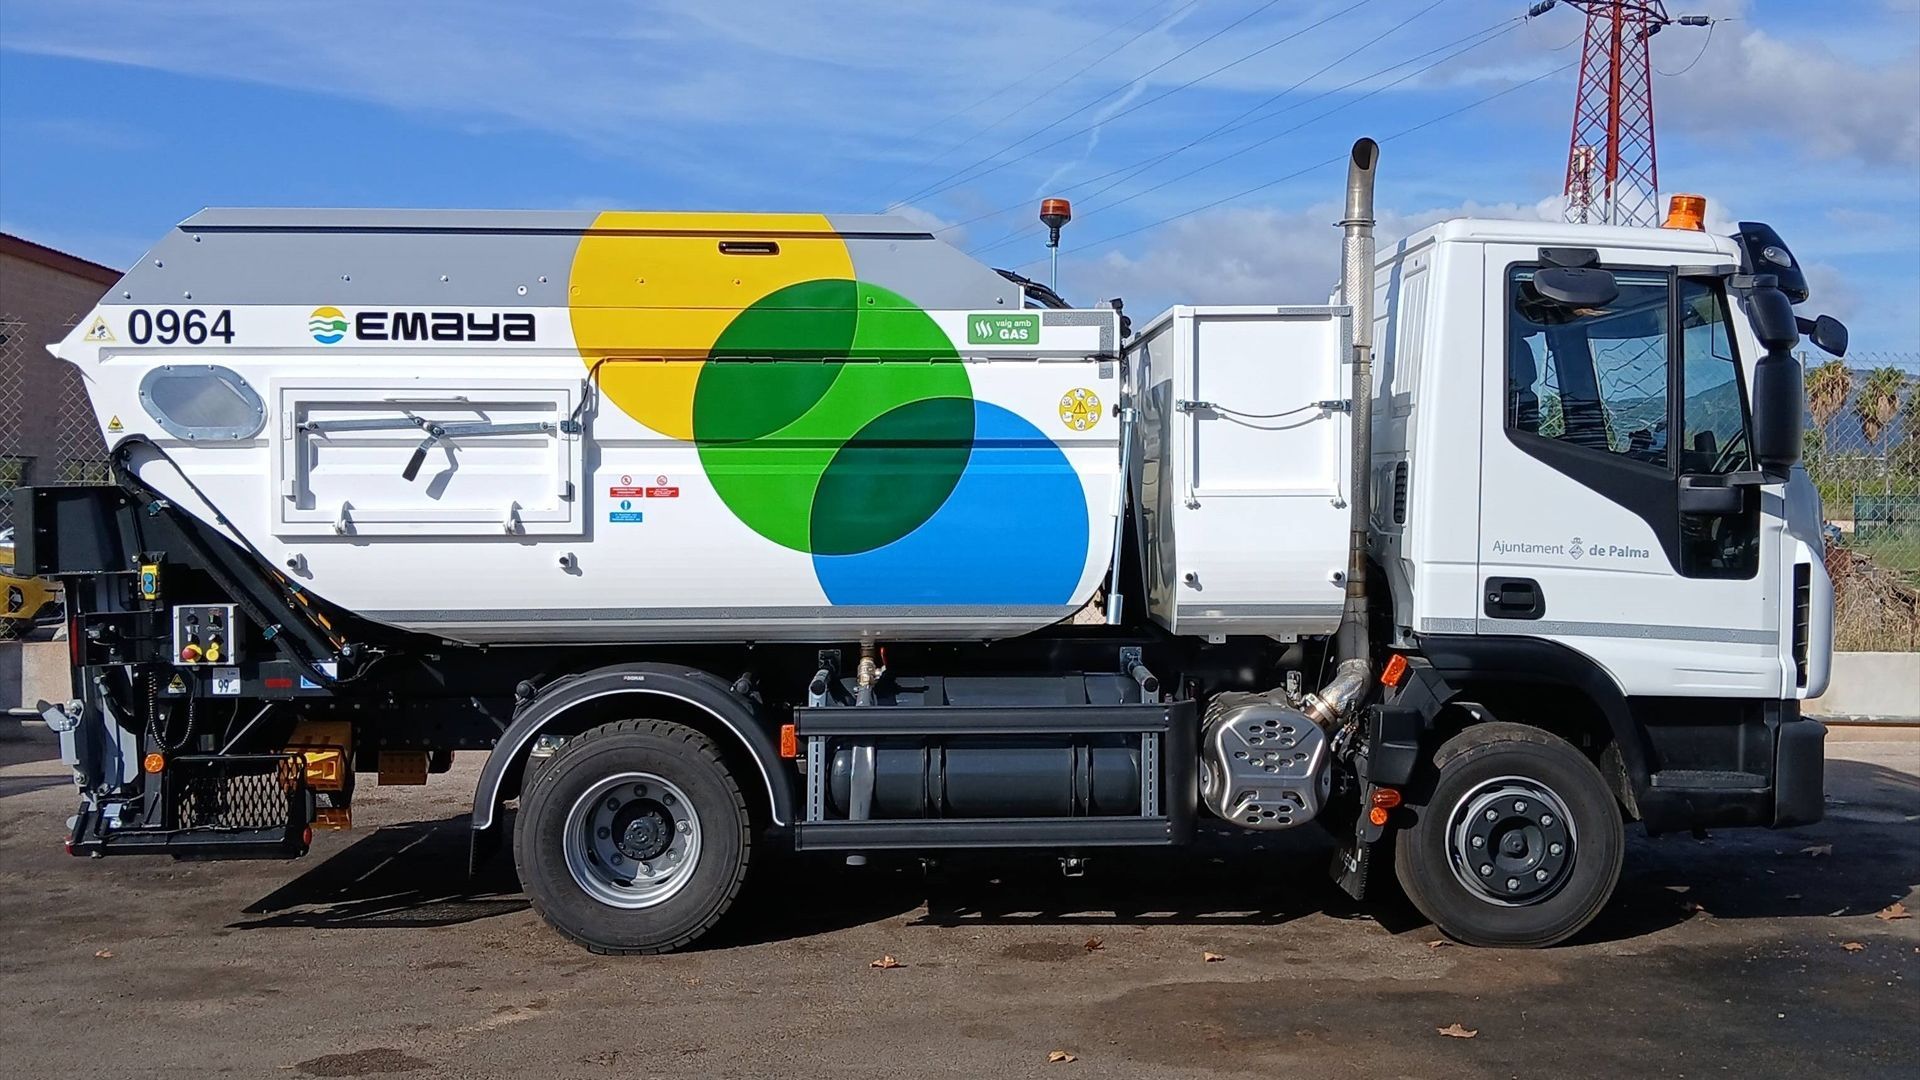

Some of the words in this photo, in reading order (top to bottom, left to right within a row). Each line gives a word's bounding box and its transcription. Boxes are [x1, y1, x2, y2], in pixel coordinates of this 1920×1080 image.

[128, 309, 235, 345] 0964
[996, 319, 1012, 328] vaig
[1014, 319, 1032, 327] amb
[999, 329, 1029, 340] GAS
[1492, 540, 1564, 555] Ajuntament
[1589, 545, 1606, 556] de
[1609, 545, 1650, 559] Palma
[218, 679, 229, 693] 99
